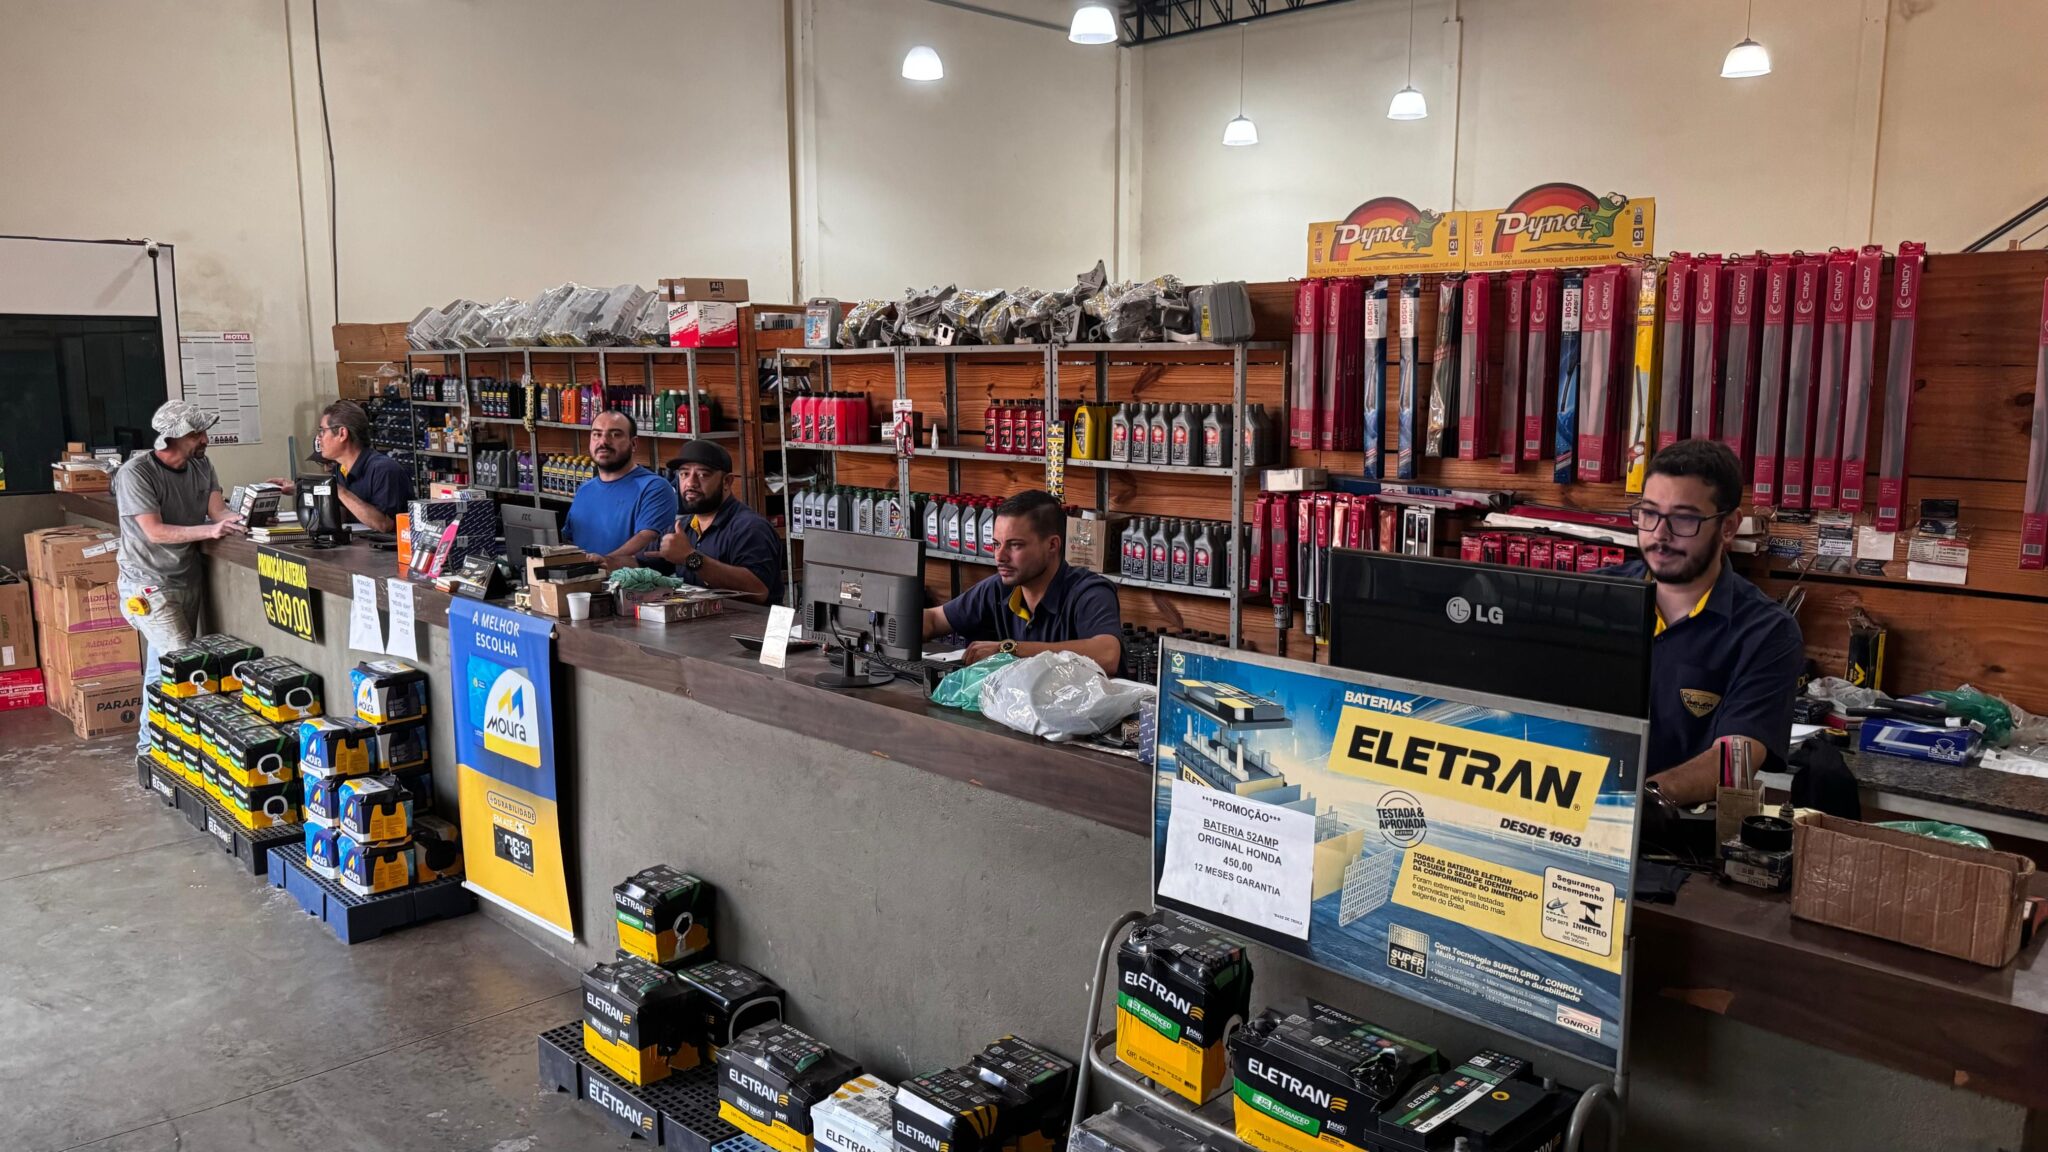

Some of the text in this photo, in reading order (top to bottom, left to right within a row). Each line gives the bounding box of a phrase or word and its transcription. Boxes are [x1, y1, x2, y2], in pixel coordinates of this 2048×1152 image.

[1335, 223, 1416, 250] Dyna
[1498, 212, 1593, 241] Dyna
[1738, 274, 1747, 304] CINDY
[1834, 270, 1842, 301] CINDY
[1863, 266, 1871, 294] CINDY
[1901, 263, 1910, 296] CINDY
[1401, 296, 1409, 325] BOSCH
[1565, 291, 1573, 317] BOSCH
[1602, 282, 1610, 310] CINDY
[669, 304, 688, 318] SPICER
[258, 552, 307, 589] PROMOÇÃO BATERIAS
[272, 590, 312, 635] 189,00
[472, 611, 520, 638] A MELHOR
[1476, 603, 1504, 625] LG
[475, 632, 518, 658] ESCOLHA
[96, 697, 143, 712] PARAFL
[1344, 690, 1413, 714] BATERIAS
[1347, 725, 1582, 809] ELETRAN
[1203, 818, 1279, 848] BATERIA 52AMP
[1379, 818, 1427, 830] APROVADA
[1500, 817, 1582, 848] DESDE 1963
[1198, 832, 1282, 866] ORIGINAL HONDA
[1223, 856, 1253, 873] 450,00
[1413, 852, 1512, 885] TODAS AS BATERIAS ELETRAN
[1413, 858, 1445, 872] POSSUEM
[1454, 870, 1472, 880] SELO
[1484, 879, 1539, 900] IDENTIFICAÇÃO
[1194, 863, 1281, 897] 12 MESES GARANTIA
[1413, 865, 1523, 903] DA CONFORMIDADE DO INMETRO
[1413, 875, 1432, 886] Foram
[1478, 894, 1504, 908] testadas
[1552, 882, 1604, 902] Desempenho
[1557, 874, 1600, 892] Segurança
[615, 893, 646, 916] ELETRAN
[1412, 891, 1436, 903] exigente
[1438, 898, 1446, 906] do
[1417, 884, 1449, 901] aprovadas
[1450, 894, 1463, 905] pelo
[1465, 898, 1488, 911] instituto
[1490, 906, 1505, 916] mais
[1572, 922, 1607, 938] INMETRO
[1390, 949, 1425, 969] SUPER
[1390, 957, 1424, 975] GRID
[1434, 941, 1450, 953] Com
[1452, 946, 1492, 966] Tecnologia
[1493, 959, 1519, 975] SUPER
[1520, 970, 1540, 982] GRID
[1546, 978, 1583, 996] CONROLL
[1436, 950, 1455, 962] Muito
[1457, 956, 1475, 968] mais
[1476, 962, 1523, 985] desempenho
[1531, 980, 1581, 1003] durabilidade
[586, 992, 624, 1023] ELETRAN
[1124, 971, 1192, 1015] ELETRAN
[1140, 1007, 1172, 1030] ADVANCED
[1313, 1004, 1355, 1023] ELETRAN
[1557, 1015, 1599, 1034] CONROLL
[729, 1068, 779, 1104] ELETRAN
[1248, 1057, 1331, 1109] ELETRAN
[589, 1083, 642, 1126] ELETRAN
[1272, 1104, 1310, 1126] ADVANCED
[897, 1120, 941, 1151] ELETRAN
